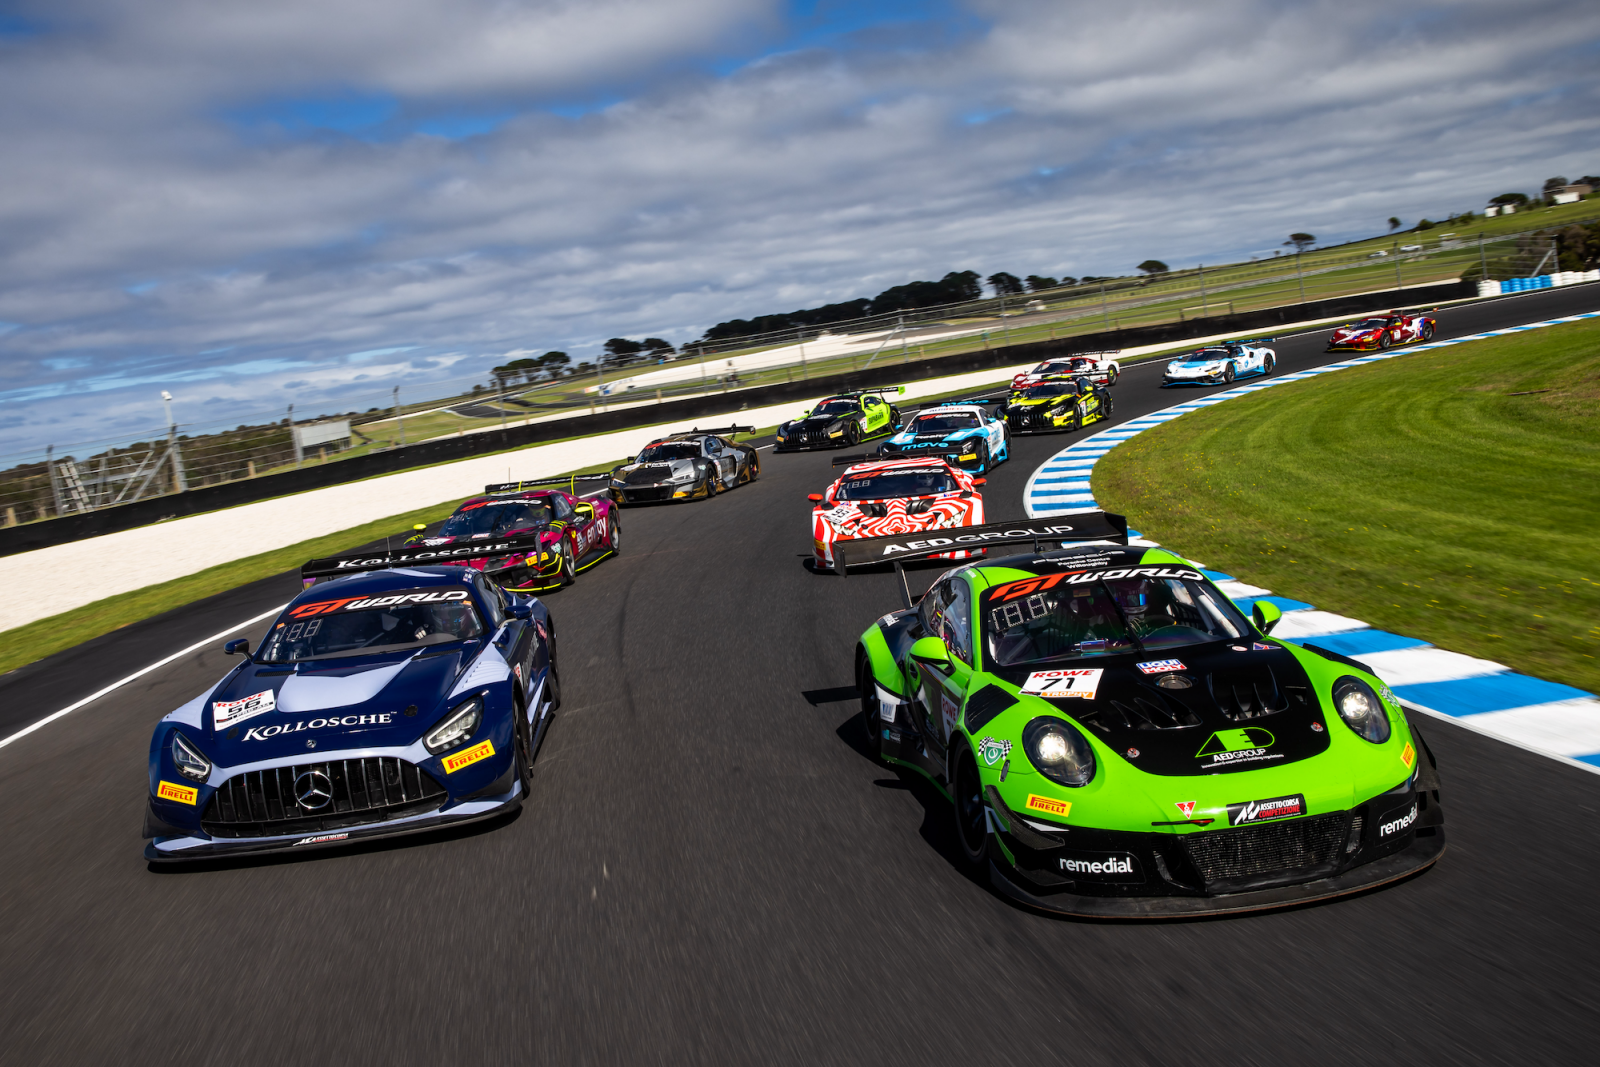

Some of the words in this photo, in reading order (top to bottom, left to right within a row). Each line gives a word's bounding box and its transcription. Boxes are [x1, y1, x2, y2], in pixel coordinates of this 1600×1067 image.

[902, 442, 949, 451] move
[848, 470, 893, 480] GT
[881, 468, 945, 477] WORLD
[988, 570, 1088, 602] GT
[1065, 568, 1204, 585] WORLD
[289, 596, 370, 619] GT
[345, 590, 469, 610] WORLD
[1140, 660, 1179, 669] LIQUI
[1145, 665, 1184, 674] MOLY
[1032, 669, 1095, 679] ROWE
[1040, 677, 1075, 690] 71
[216, 692, 266, 708] ROWE
[447, 744, 490, 770] PIRELLI
[160, 784, 194, 802] PIRELLI
[1030, 796, 1067, 814] PIRELLI
[1259, 805, 1300, 818] COMPETIZIONE
[1260, 800, 1283, 811] ASSETTO
[1282, 798, 1300, 808] CORSA
[1379, 802, 1418, 838] remedial
[1060, 857, 1133, 874] remedial
